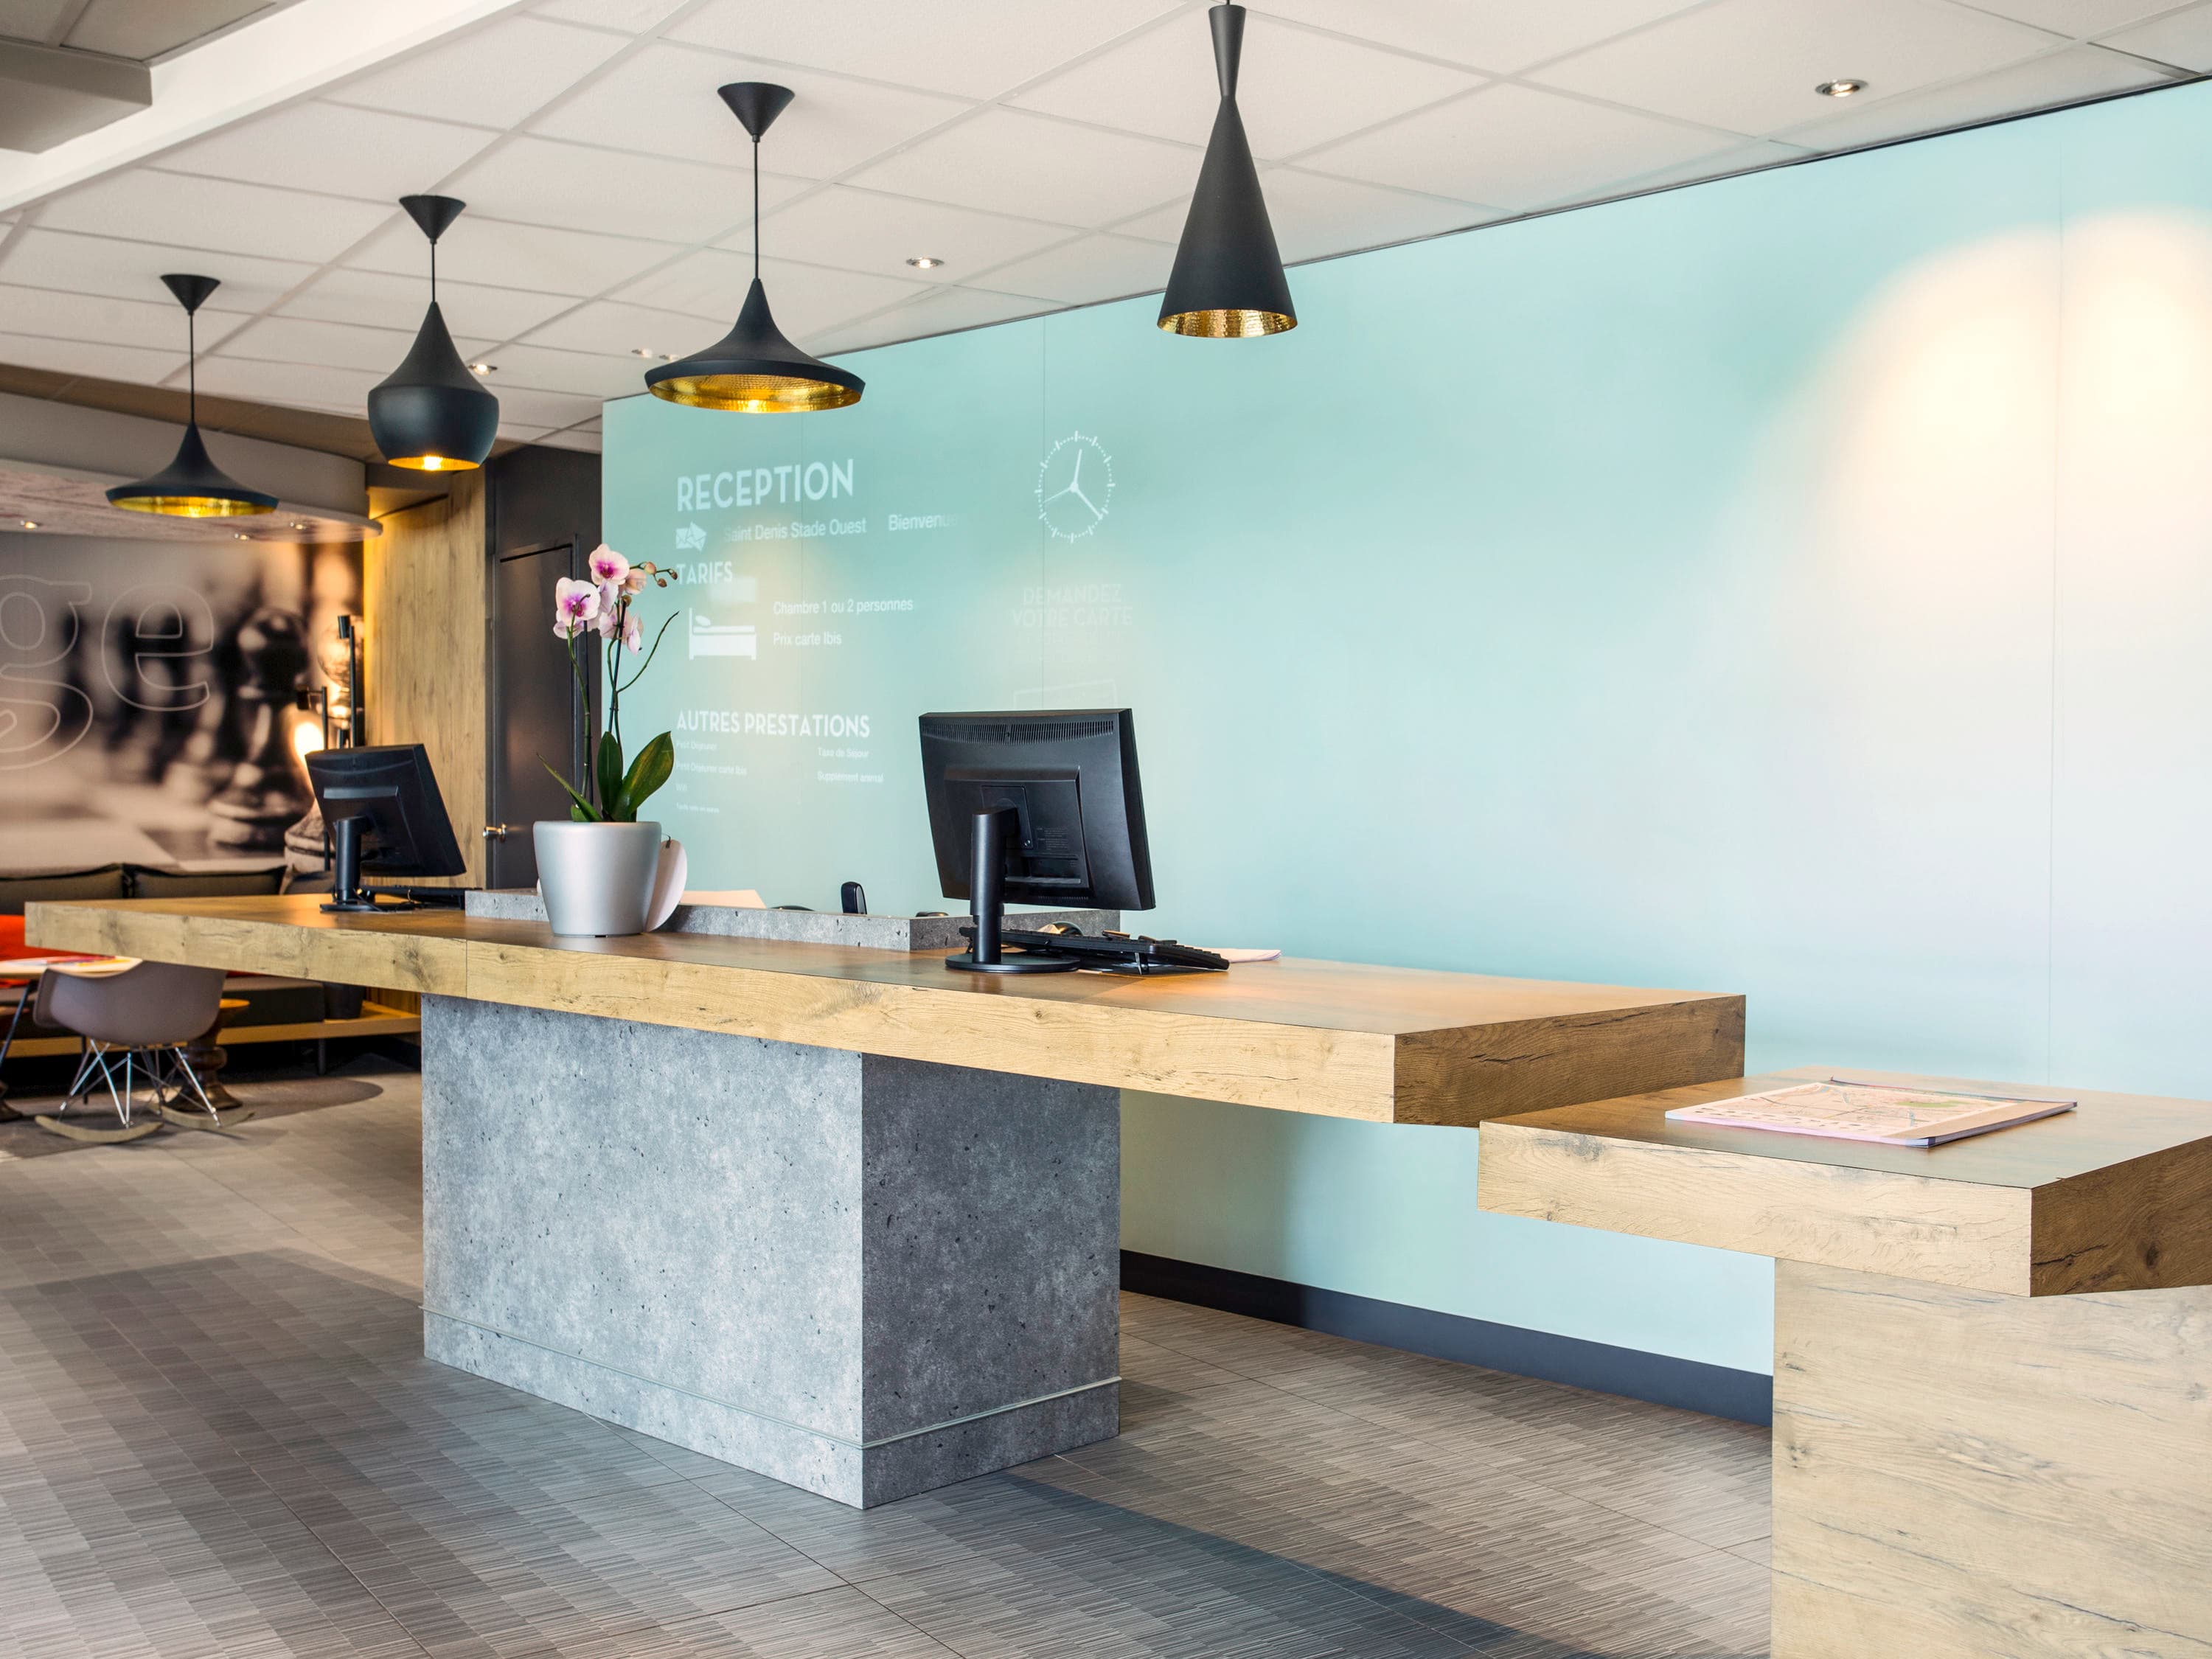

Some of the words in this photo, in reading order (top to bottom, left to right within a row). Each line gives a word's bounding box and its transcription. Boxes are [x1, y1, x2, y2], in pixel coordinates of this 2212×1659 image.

[677, 459, 854, 512] RECEPTION
[724, 526, 752, 542] Saint
[755, 523, 787, 540] Denis
[790, 521, 826, 538] Stade
[830, 518, 867, 535] Ouest
[676, 561, 733, 584] TARIFS
[1023, 583, 1121, 605] DEMANDEZ
[773, 600, 819, 614] Chambre
[822, 600, 827, 613] 1
[831, 602, 844, 613] ou
[847, 599, 854, 612] 2
[856, 599, 914, 615] personnes
[1012, 608, 1068, 627] VOTRE
[1074, 605, 1133, 626] CARTE
[773, 632, 792, 646] Prix
[795, 633, 821, 645] carte
[823, 631, 842, 645] Ibis
[676, 710, 740, 733] AUTRES
[745, 712, 870, 738] PRESTATIONS
